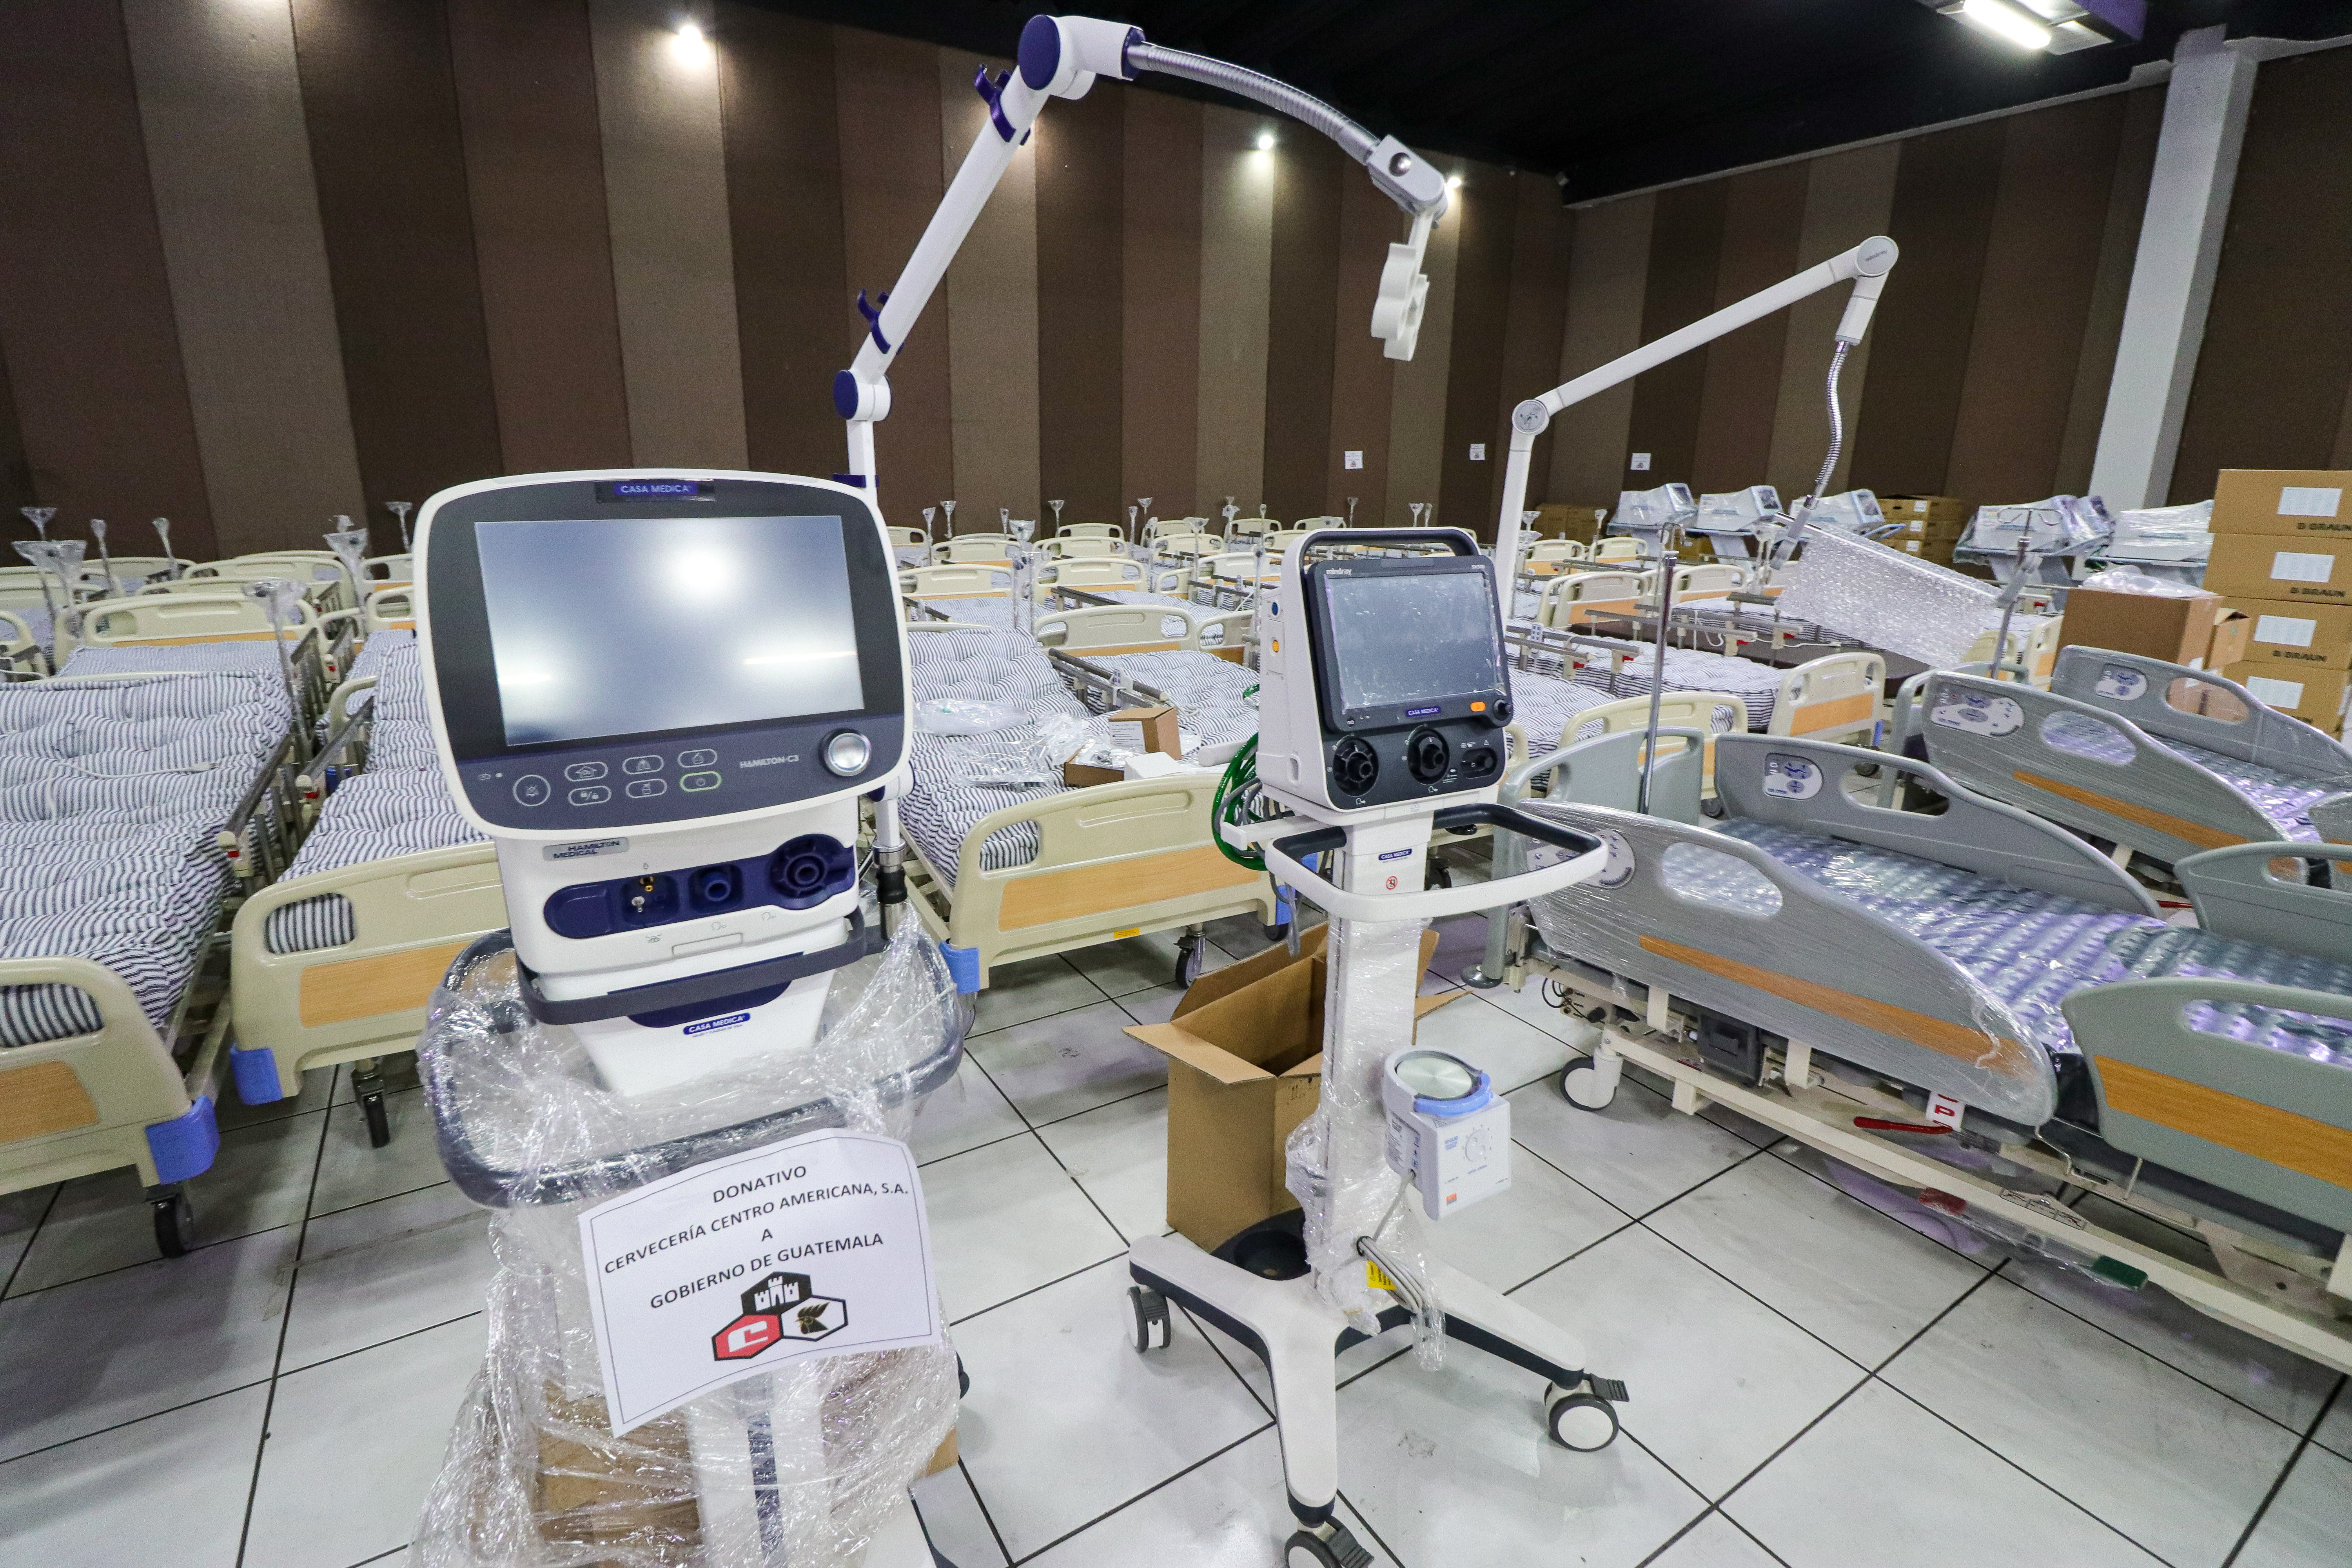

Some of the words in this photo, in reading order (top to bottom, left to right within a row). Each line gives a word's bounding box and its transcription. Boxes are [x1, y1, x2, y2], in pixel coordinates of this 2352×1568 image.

[739, 755, 800, 768] HAMILTON-C3
[568, 840, 620, 851] HAMILTON
[553, 849, 598, 858] MEDICAL
[688, 1024, 711, 1033] CASA
[712, 1016, 744, 1027] MEDICA
[713, 1166, 807, 1203] DONATIVO
[605, 1224, 706, 1274] CERVECERÍA
[711, 1202, 774, 1232] CENTRO
[780, 1183, 878, 1209] AMERICANA,
[881, 1183, 909, 1194] S.A.
[762, 1229, 773, 1241] A
[650, 1265, 745, 1308] GOBIERNO
[750, 1254, 771, 1272] DE
[777, 1233, 883, 1262] GUATEMALA
